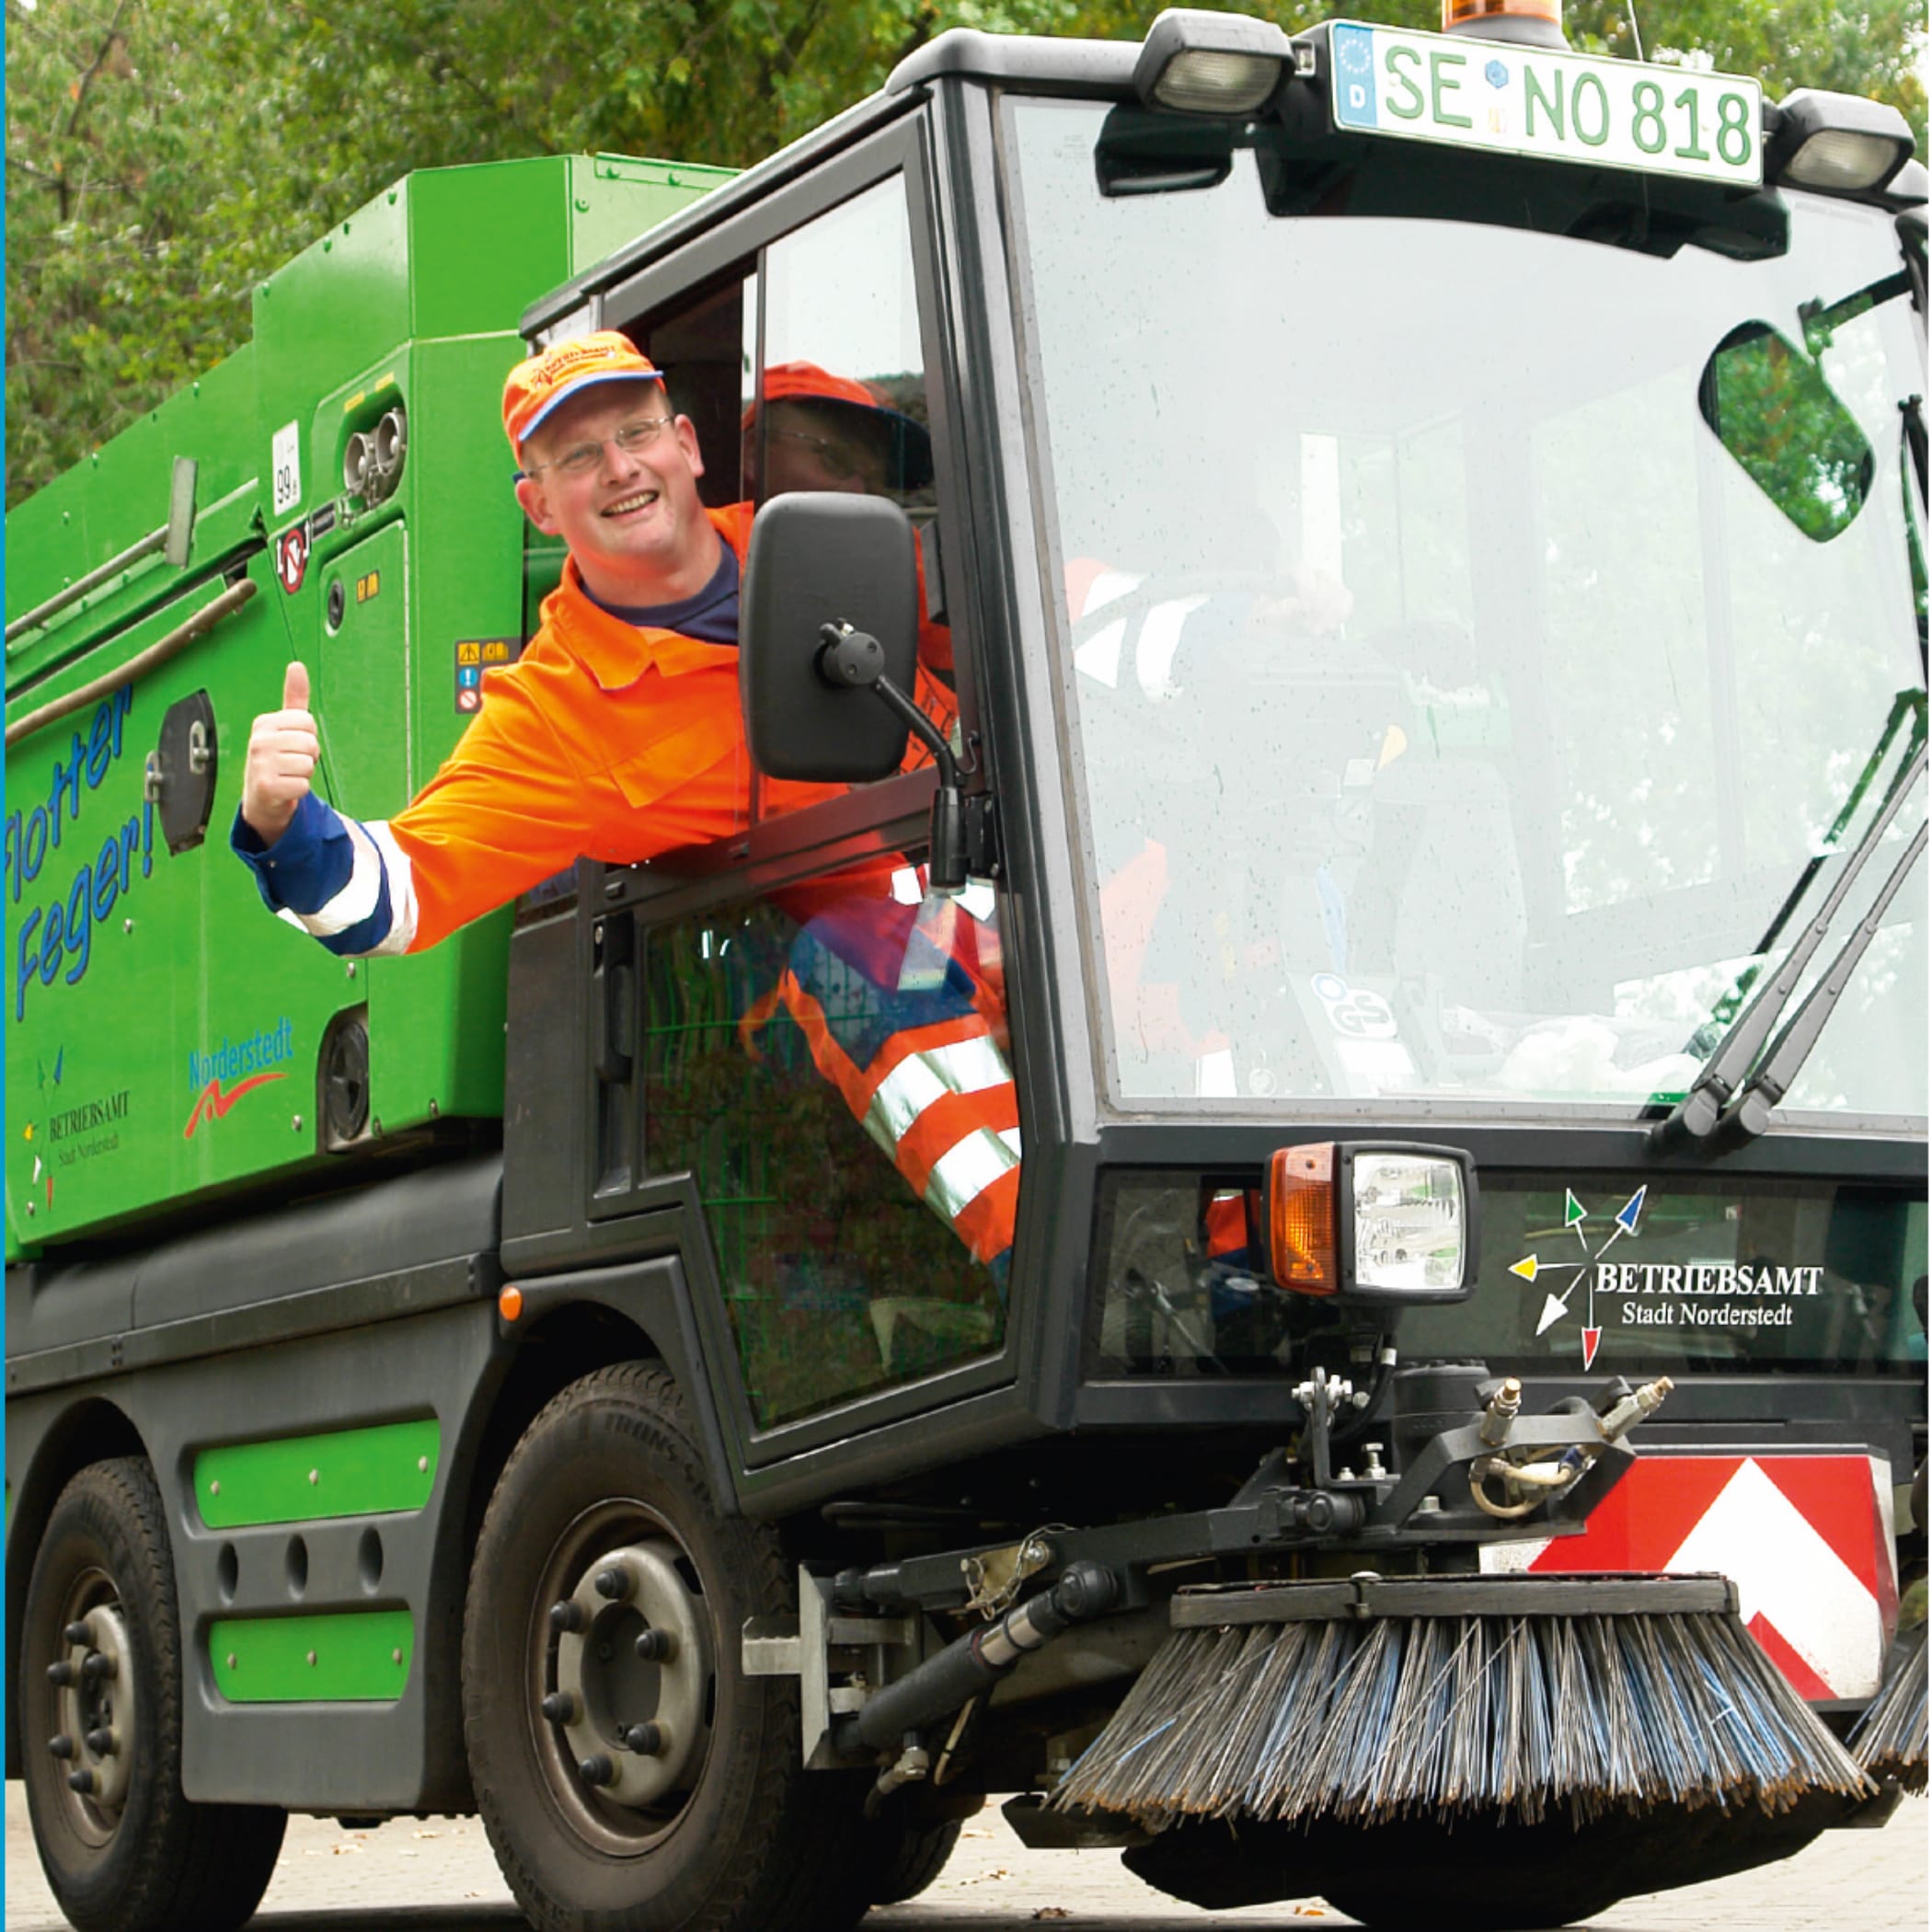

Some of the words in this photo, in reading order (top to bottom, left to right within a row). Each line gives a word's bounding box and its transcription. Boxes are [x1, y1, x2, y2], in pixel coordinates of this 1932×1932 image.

[1349, 84, 1366, 109] D
[1384, 45, 1472, 129] SE
[1524, 64, 1610, 146] NO
[1631, 80, 1752, 166] 818
[277, 464, 291, 504] 99
[6, 683, 132, 903] lotter
[16, 760, 154, 1023] Feger!
[189, 1015, 293, 1093] Norderstedt
[50, 1088, 131, 1144] BETRIEBSAMT
[1594, 1262, 1823, 1295] BETRIEBSAMT
[1621, 1301, 1674, 1326] Stadt
[1679, 1302, 1794, 1326] Norderstedt
